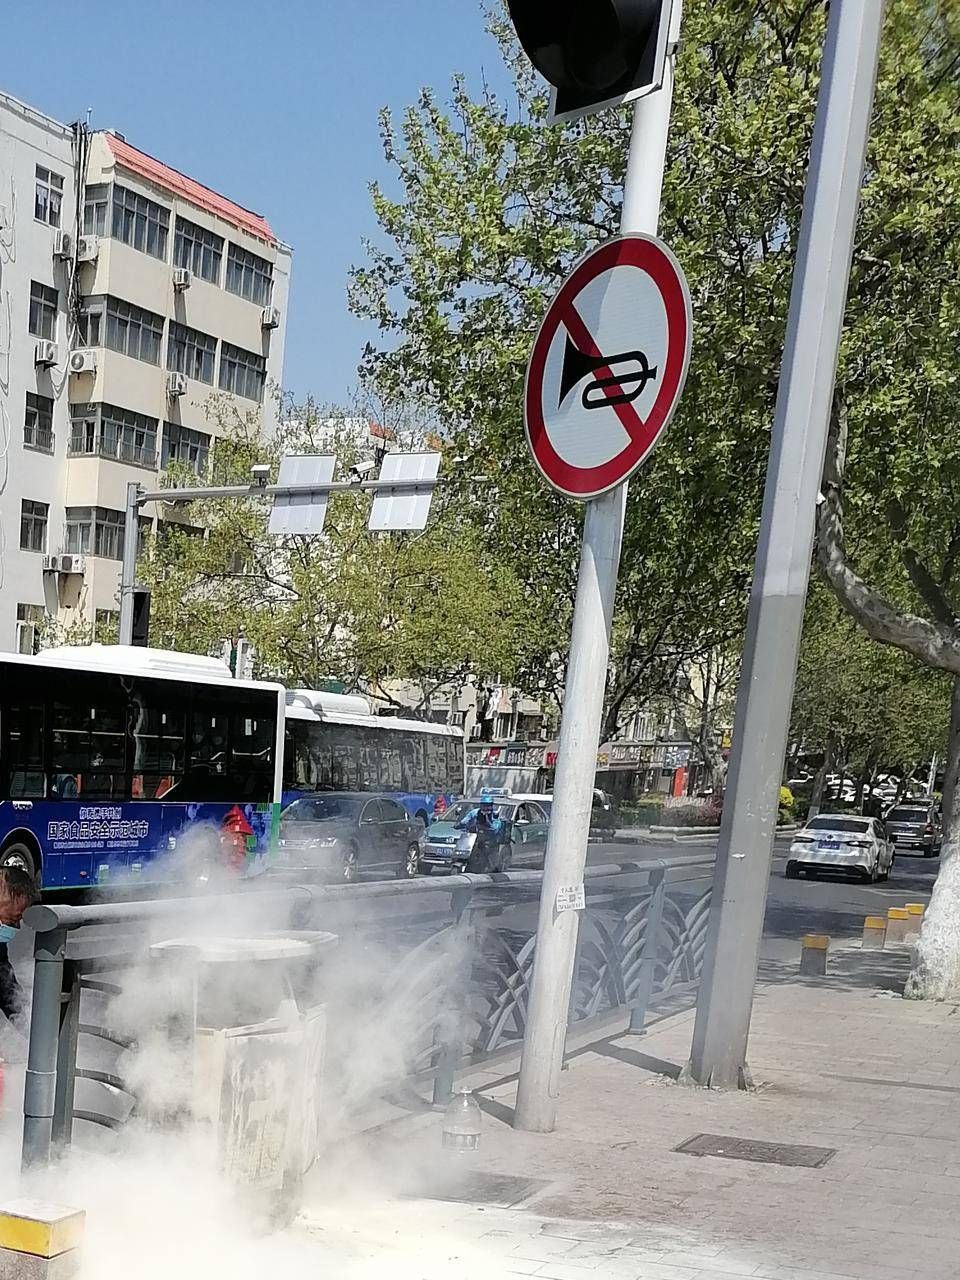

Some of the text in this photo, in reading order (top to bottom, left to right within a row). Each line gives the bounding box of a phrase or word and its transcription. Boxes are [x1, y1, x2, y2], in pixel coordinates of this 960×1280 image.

[47, 820, 149, 840] 国家食品安全示范城市
